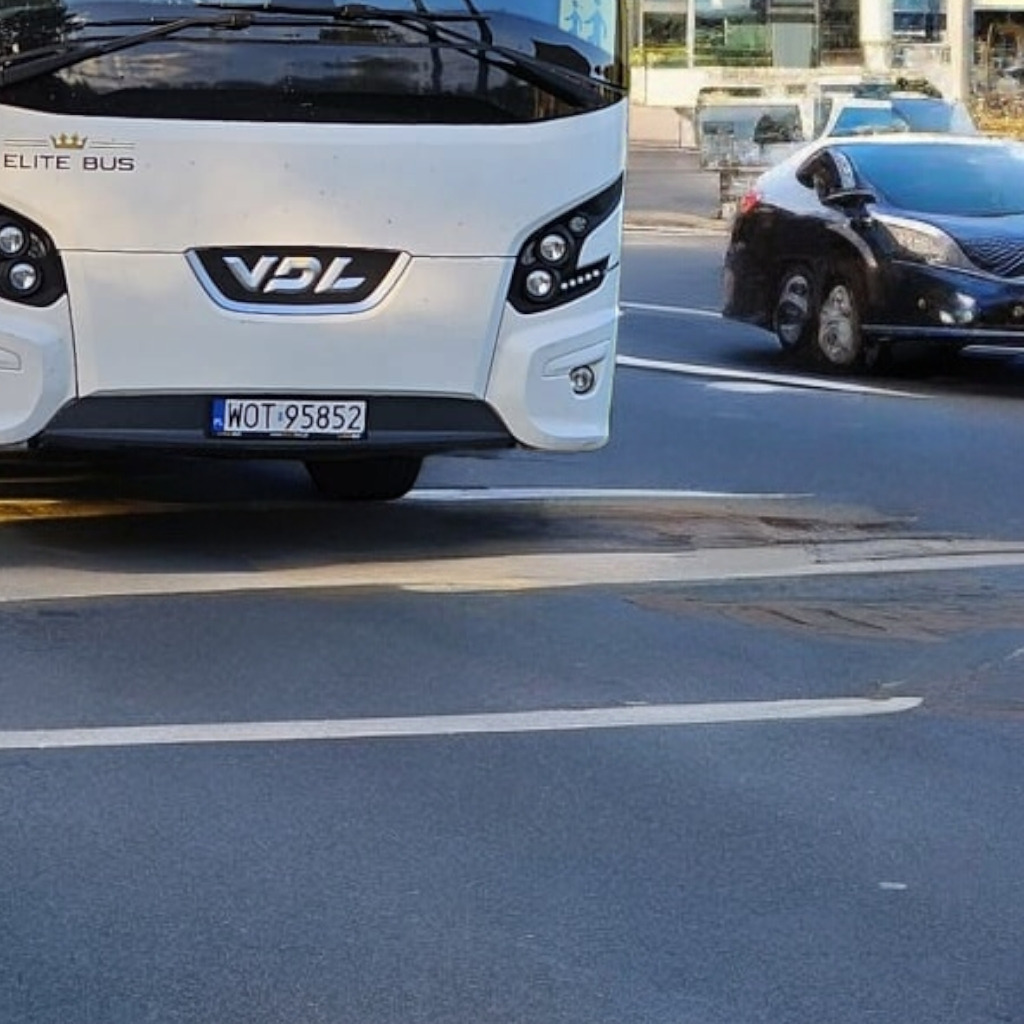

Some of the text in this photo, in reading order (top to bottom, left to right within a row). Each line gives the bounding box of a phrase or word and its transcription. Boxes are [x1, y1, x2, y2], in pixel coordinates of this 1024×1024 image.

[4, 154, 135, 171] ELITE BUS
[222, 256, 366, 293] VDL
[228, 402, 362, 430] WOT 95852
